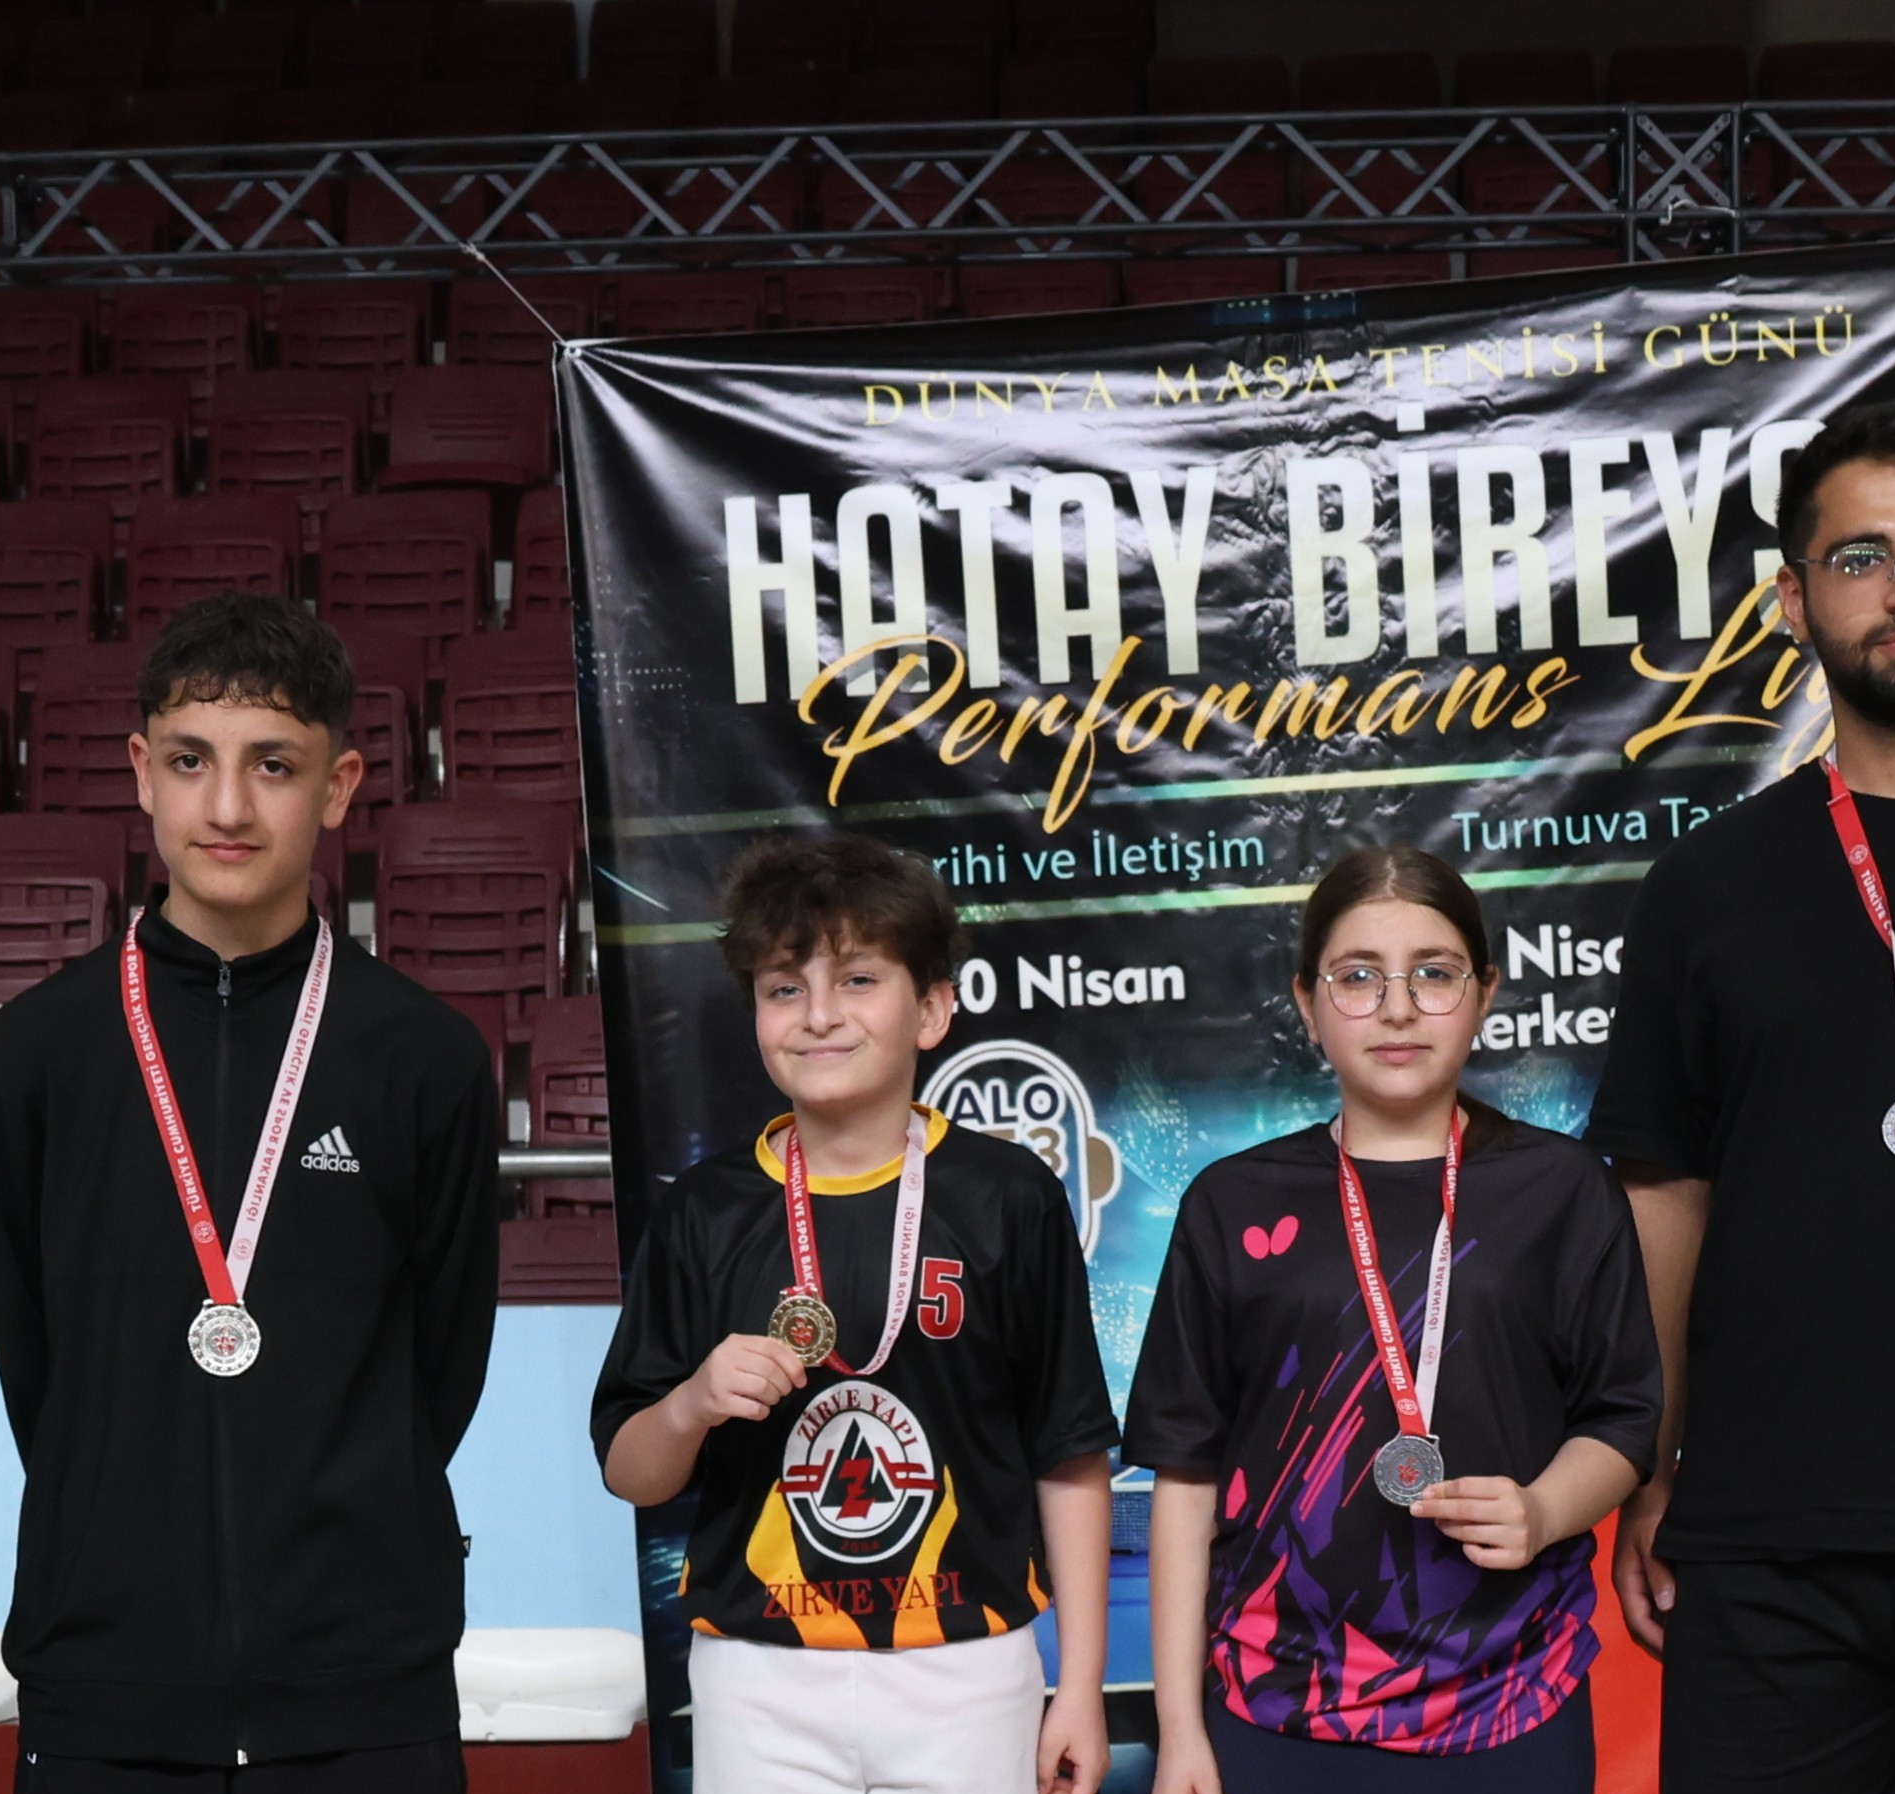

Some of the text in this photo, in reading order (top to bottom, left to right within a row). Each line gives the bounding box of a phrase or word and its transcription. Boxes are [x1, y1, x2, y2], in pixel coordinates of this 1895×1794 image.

[863, 304, 1856, 426] DÜNYA MASA TENİSİ GÜNÜ
[723, 464, 1219, 705] HATAY
[797, 633, 1582, 835] Performans
[1022, 848, 1076, 882] ve
[1091, 829, 1265, 882] İletişim
[1450, 811, 1648, 853] Turnuva
[1860, 869, 1888, 920] TÜRKİYE
[127, 953, 140, 986] SPOR
[129, 986, 140, 1003] VE
[1016, 953, 1186, 1010] Nisan
[130, 1003, 156, 1062] GENÇLİK
[145, 1064, 186, 1153] CUMHURİYETİ
[950, 1081, 1061, 1126] ALO
[177, 1157, 203, 1213] TÜRKİYE
[300, 1154, 360, 1174] adidas
[794, 1201, 806, 1219] VE
[1349, 1205, 1362, 1219] VE
[795, 1219, 811, 1253] SPOR
[1350, 1220, 1373, 1266] GENÇLİK
[916, 1256, 966, 1340] 5
[1360, 1269, 1394, 1344] CUMHURİYETİ
[1385, 1345, 1408, 1392] TÜRKİYE
[796, 1388, 920, 1450] ZİRVE YAPI
[762, 1571, 965, 1619] ZİRVE YAPI
